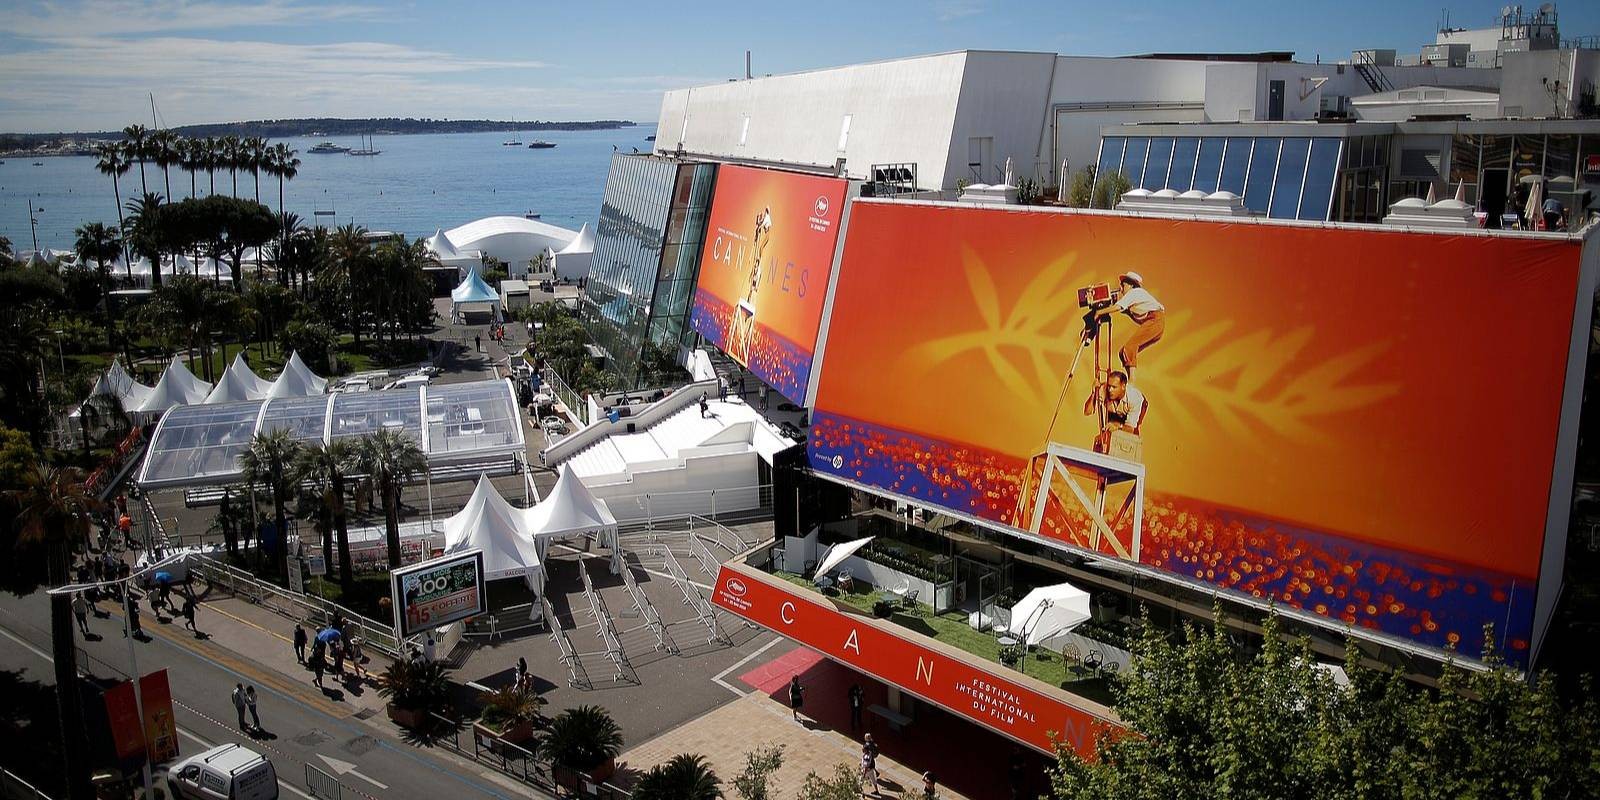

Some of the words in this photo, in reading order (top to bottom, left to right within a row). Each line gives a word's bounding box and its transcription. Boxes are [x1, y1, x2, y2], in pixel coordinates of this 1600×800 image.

[956, 682, 1036, 723] INTERNATIONAL
[973, 679, 1020, 705] FESTIVAL
[973, 701, 986, 712] DU
[991, 709, 1014, 725] FILM
